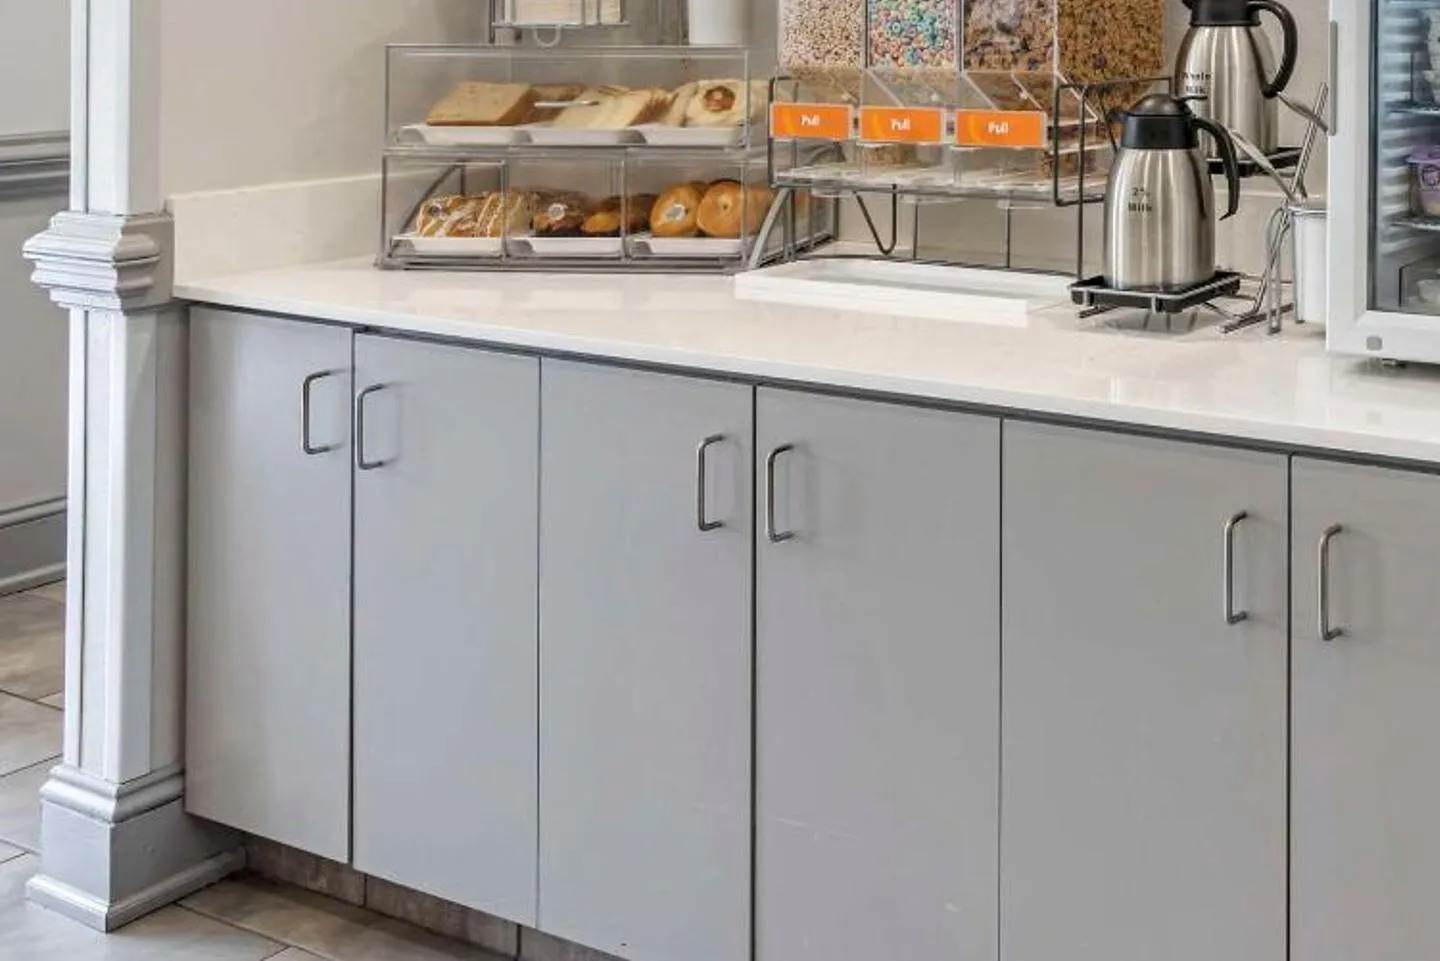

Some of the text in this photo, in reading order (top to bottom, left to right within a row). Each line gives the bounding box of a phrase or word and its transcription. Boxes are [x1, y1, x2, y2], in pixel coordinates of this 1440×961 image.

[801, 113, 821, 127] Pull
[891, 118, 911, 132] Pull
[988, 122, 1009, 135] Pull
